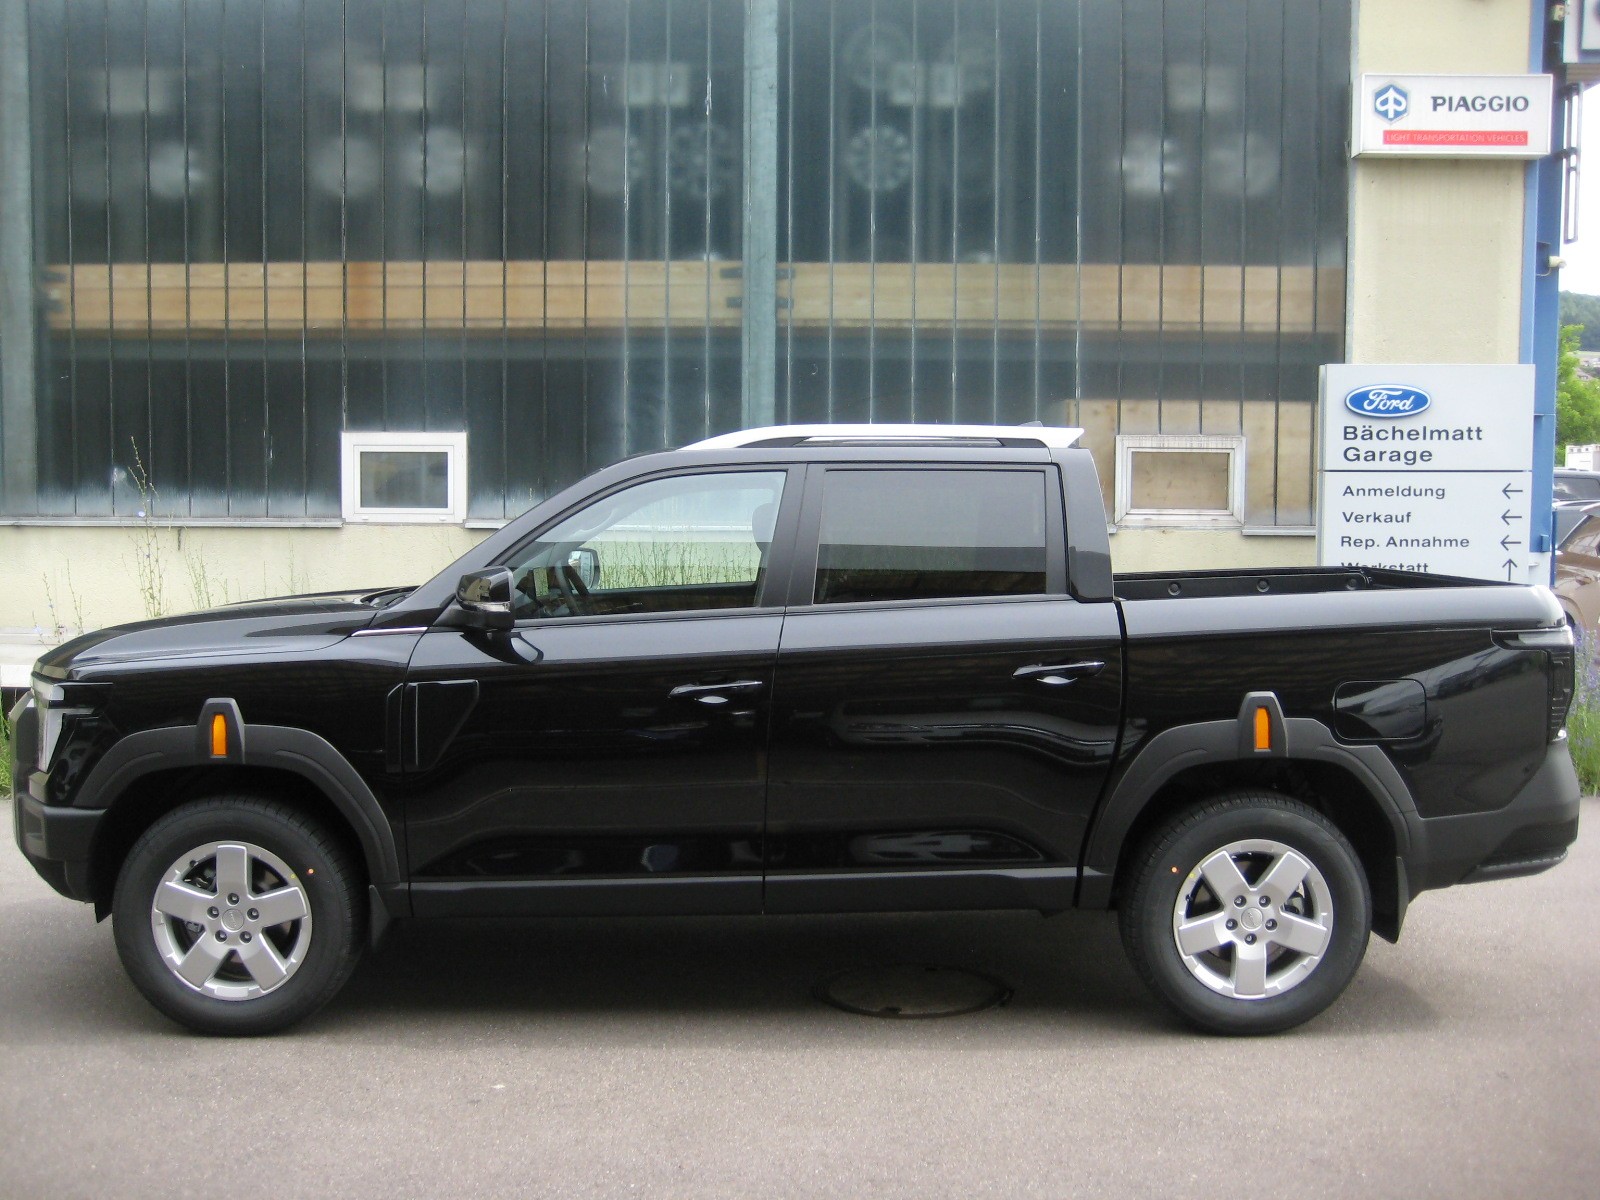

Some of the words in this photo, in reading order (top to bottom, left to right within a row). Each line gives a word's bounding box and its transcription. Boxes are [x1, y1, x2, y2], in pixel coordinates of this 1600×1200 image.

[1430, 96, 1529, 112] PIAGGIO
[1386, 133, 1410, 142] LIGHT
[1413, 133, 1485, 142] TRANSPORTATION
[1487, 134, 1525, 142] VEHICLES
[1363, 389, 1415, 411] Ford
[1343, 425, 1483, 441] Bächelmatt
[1343, 446, 1433, 466] Garage
[1342, 485, 1446, 500] Anmeldung
[1342, 511, 1412, 523] Verkauf
[1340, 536, 1380, 550] Rep.
[1385, 536, 1470, 548] Annahme
[1341, 562, 1429, 573] kstatt
